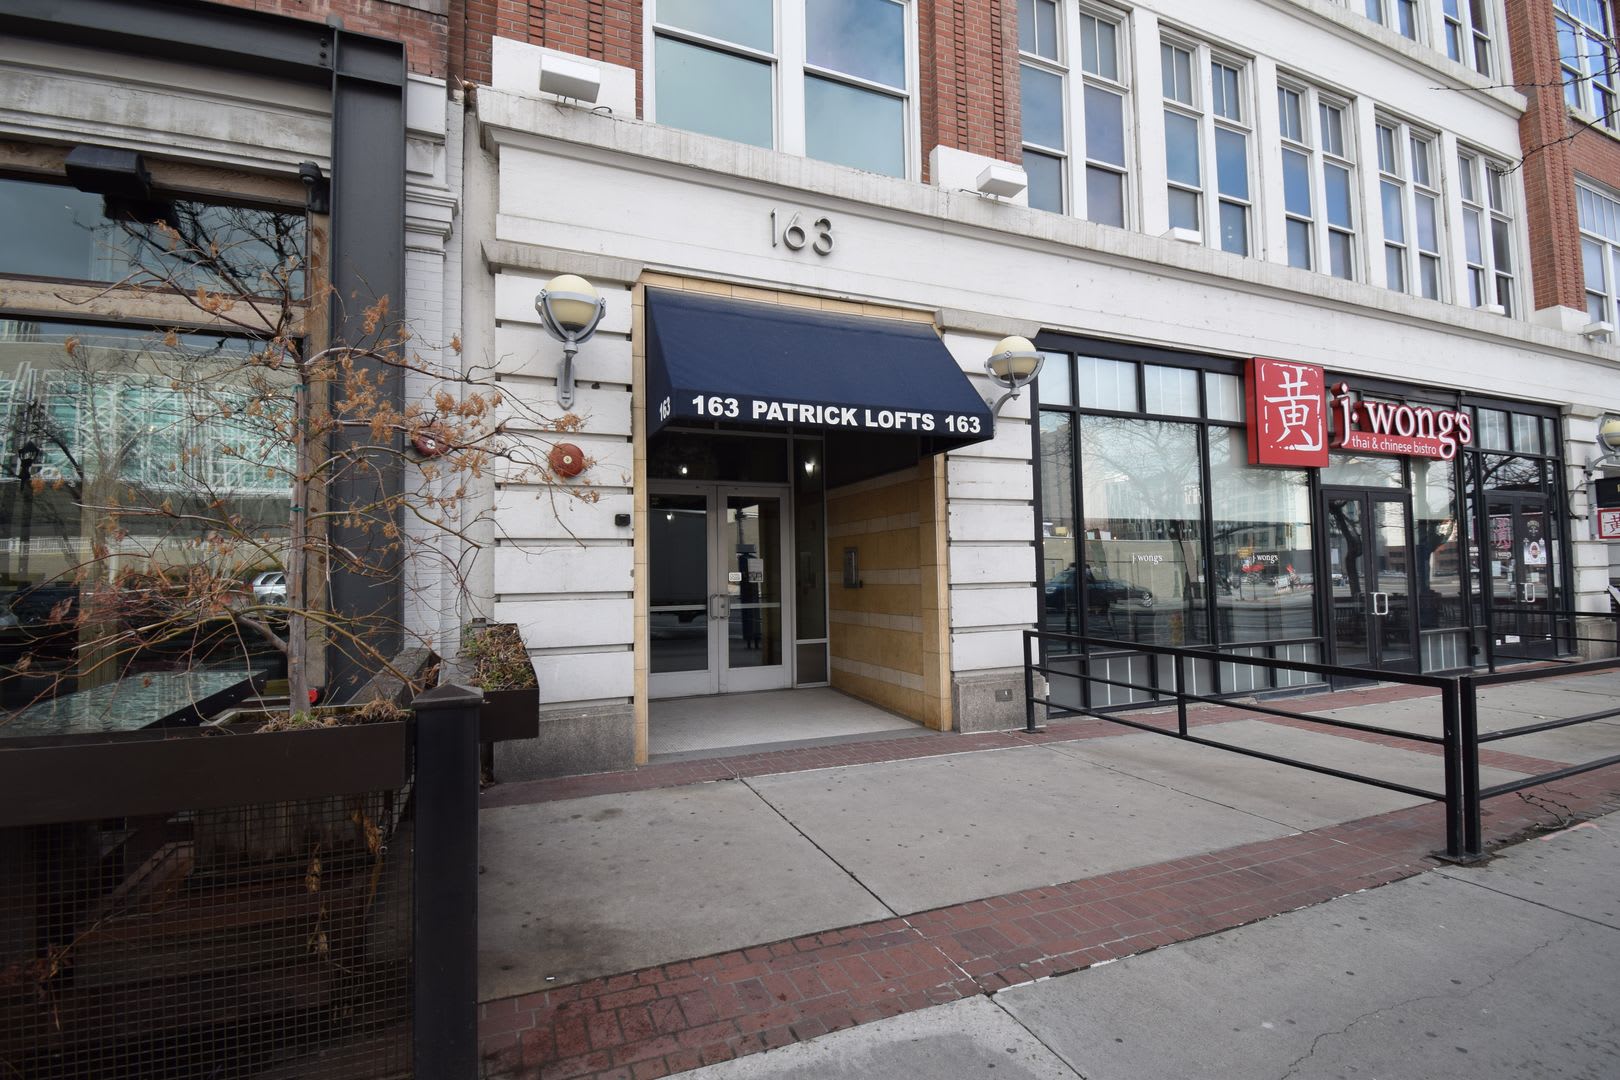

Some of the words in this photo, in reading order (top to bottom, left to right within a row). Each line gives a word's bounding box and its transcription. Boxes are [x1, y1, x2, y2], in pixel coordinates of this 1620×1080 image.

[770, 207, 834, 256] 163
[659, 396, 671, 422] 163
[692, 395, 740, 418] 163
[752, 400, 858, 427] PATRICK
[865, 409, 936, 431] LOFTS
[944, 414, 981, 434] 163
[1351, 435, 1371, 449] thai
[1372, 437, 1379, 449] &
[1380, 440, 1412, 453] chinese
[1413, 441, 1437, 455] bistro
